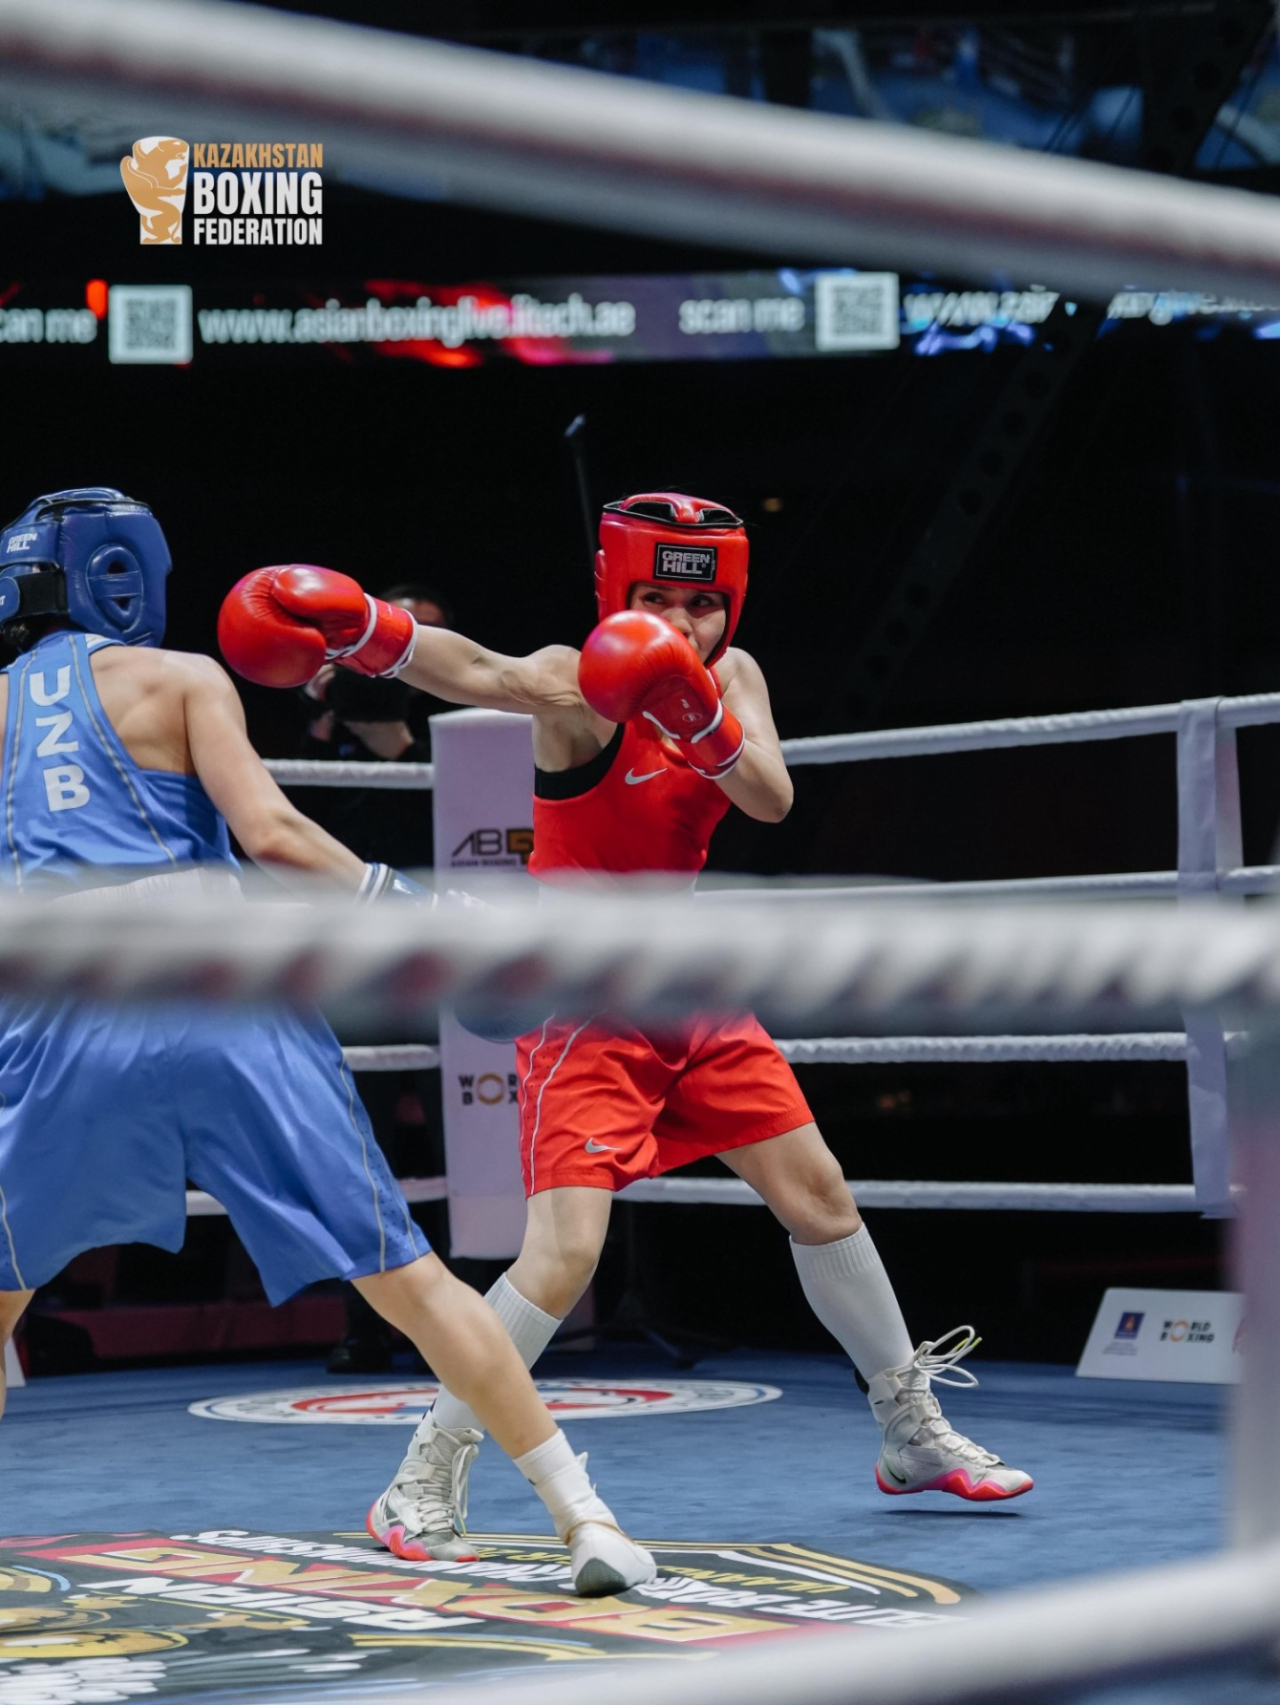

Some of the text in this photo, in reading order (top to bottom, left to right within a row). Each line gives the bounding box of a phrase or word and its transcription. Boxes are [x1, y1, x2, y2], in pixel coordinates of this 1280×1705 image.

[679, 296, 805, 334] scan me
[46, 308, 97, 343] me
[6, 540, 31, 554] HILL
[662, 550, 711, 564] GREEN
[662, 560, 703, 574] HILL
[29, 665, 91, 812] UZB
[1162, 1318, 1212, 1332] WORLD
[1159, 1332, 1215, 1343] BOXING
[78, 1576, 487, 1631] ASIAN
